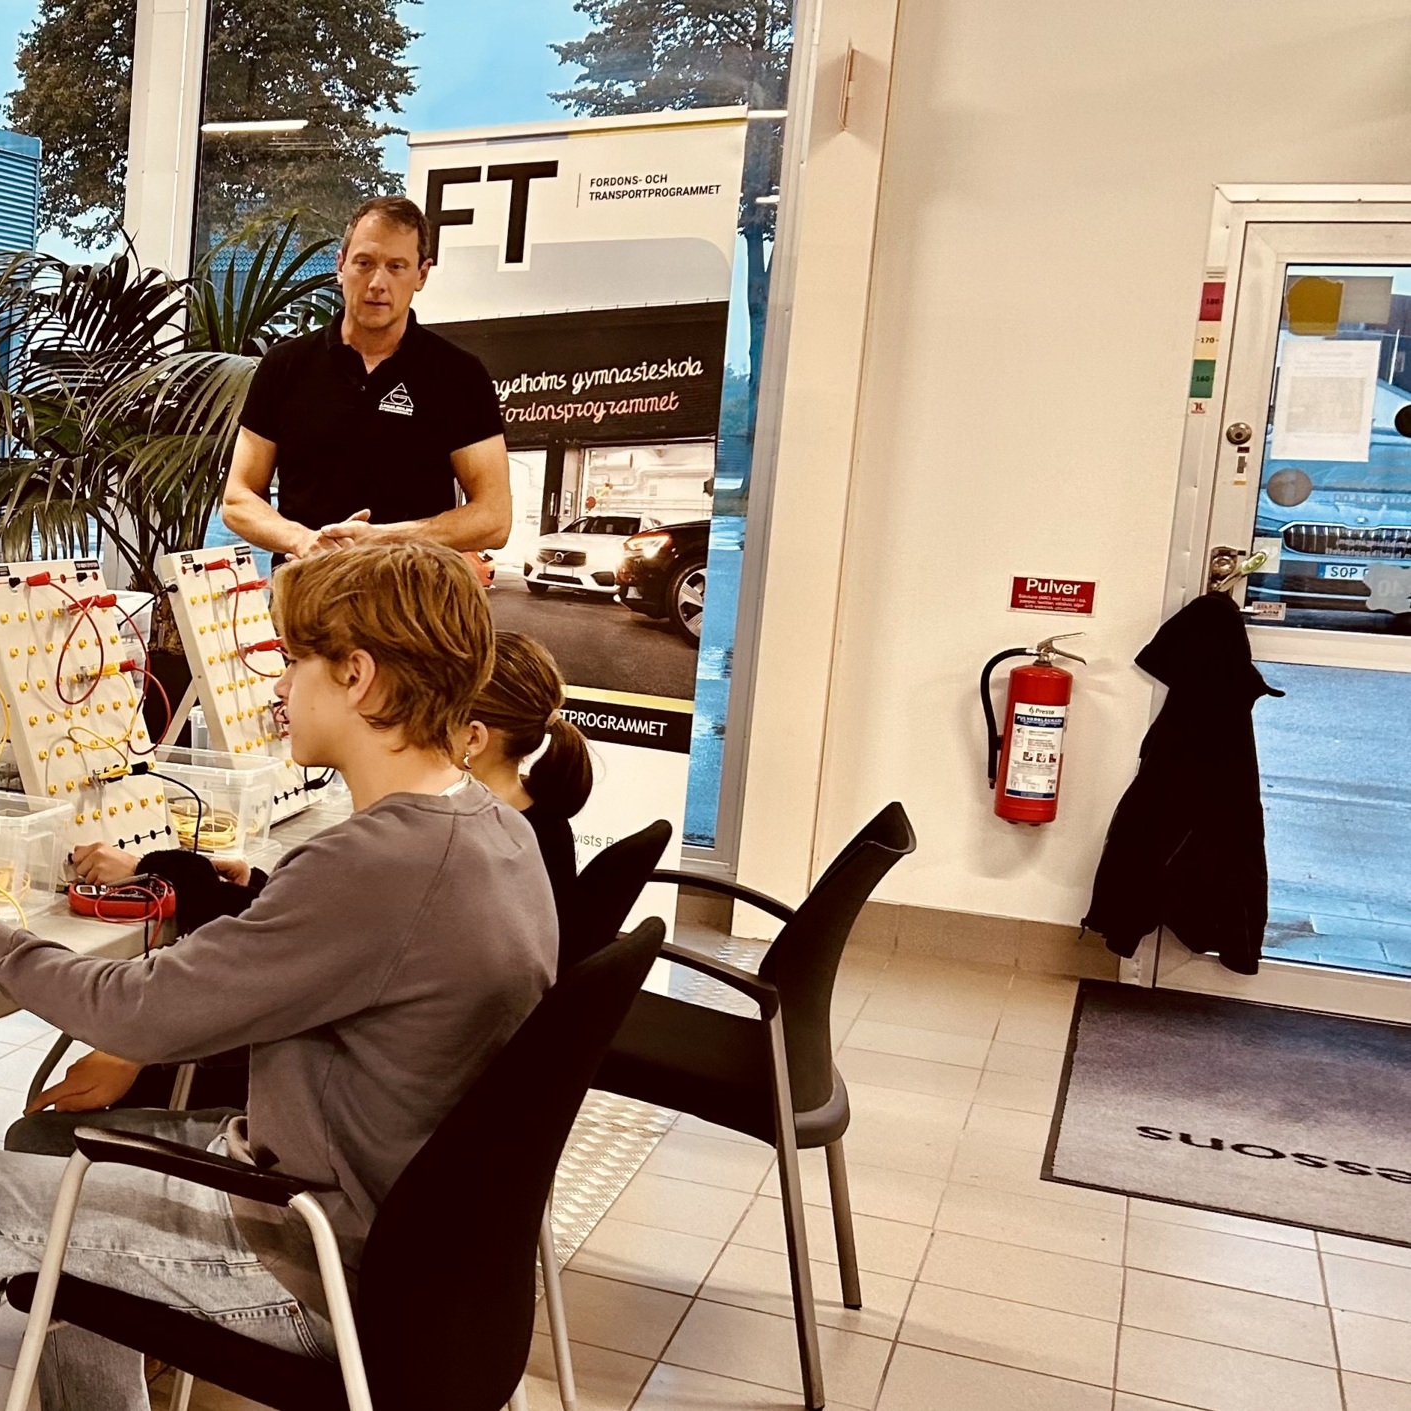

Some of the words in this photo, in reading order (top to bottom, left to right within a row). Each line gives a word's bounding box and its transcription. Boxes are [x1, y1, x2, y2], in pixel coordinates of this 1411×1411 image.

[590, 176, 643, 187] FORDONS-
[645, 174, 668, 184] OCH
[589, 184, 721, 201] TRANSPORTPROGRAMMET
[425, 160, 559, 266] FT
[492, 371, 567, 402] ngelholms
[572, 356, 703, 395] gymnasieskola
[1330, 567, 1358, 578] SOP
[1026, 578, 1081, 595] Pulver
